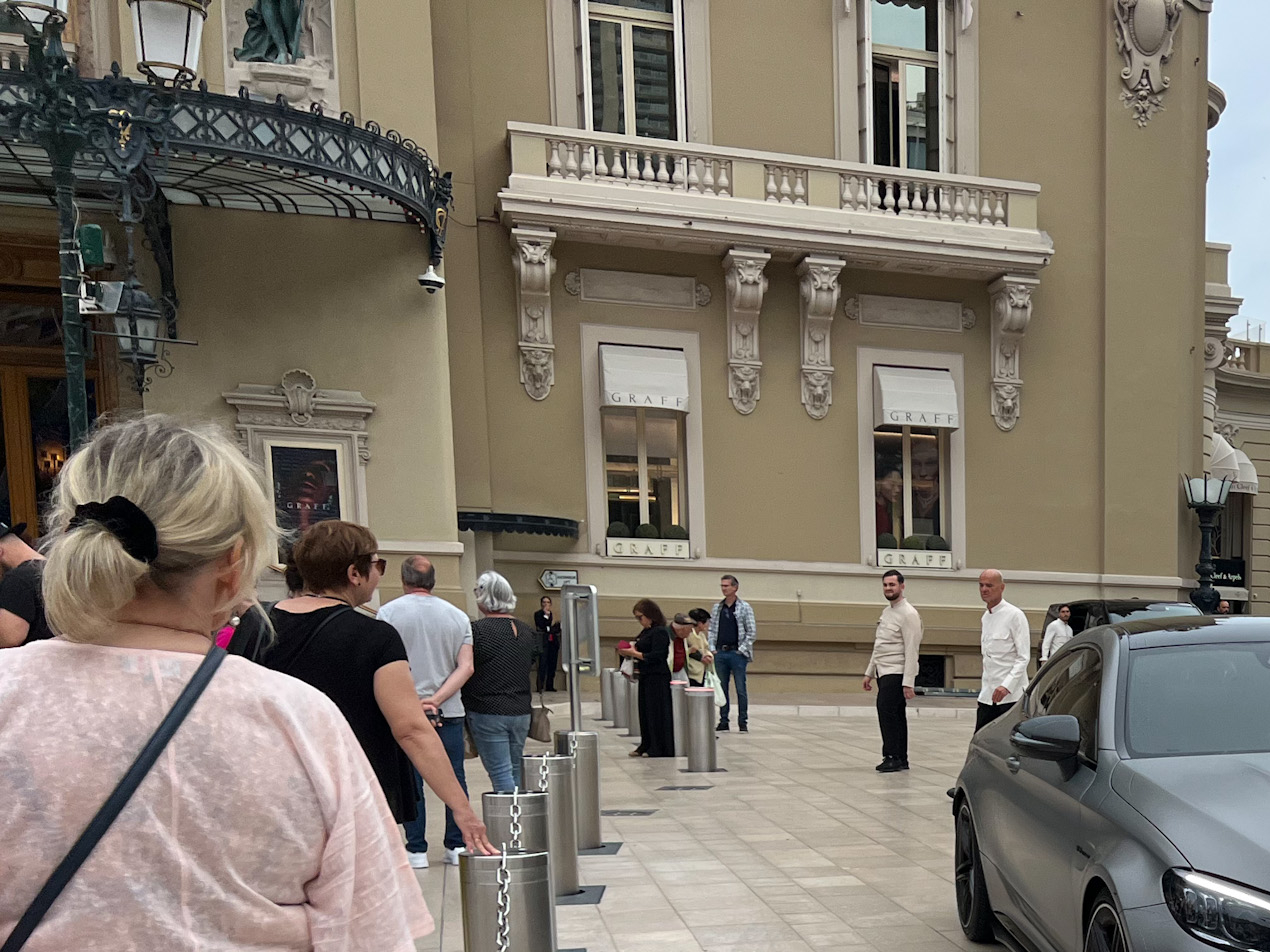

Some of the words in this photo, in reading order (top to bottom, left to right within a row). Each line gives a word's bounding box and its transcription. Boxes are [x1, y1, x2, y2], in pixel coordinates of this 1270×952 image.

[611, 392, 683, 407] GRAFF
[890, 411, 954, 424] GRAFF
[613, 542, 683, 556] GRAFF
[883, 553, 946, 566] GRAFF
